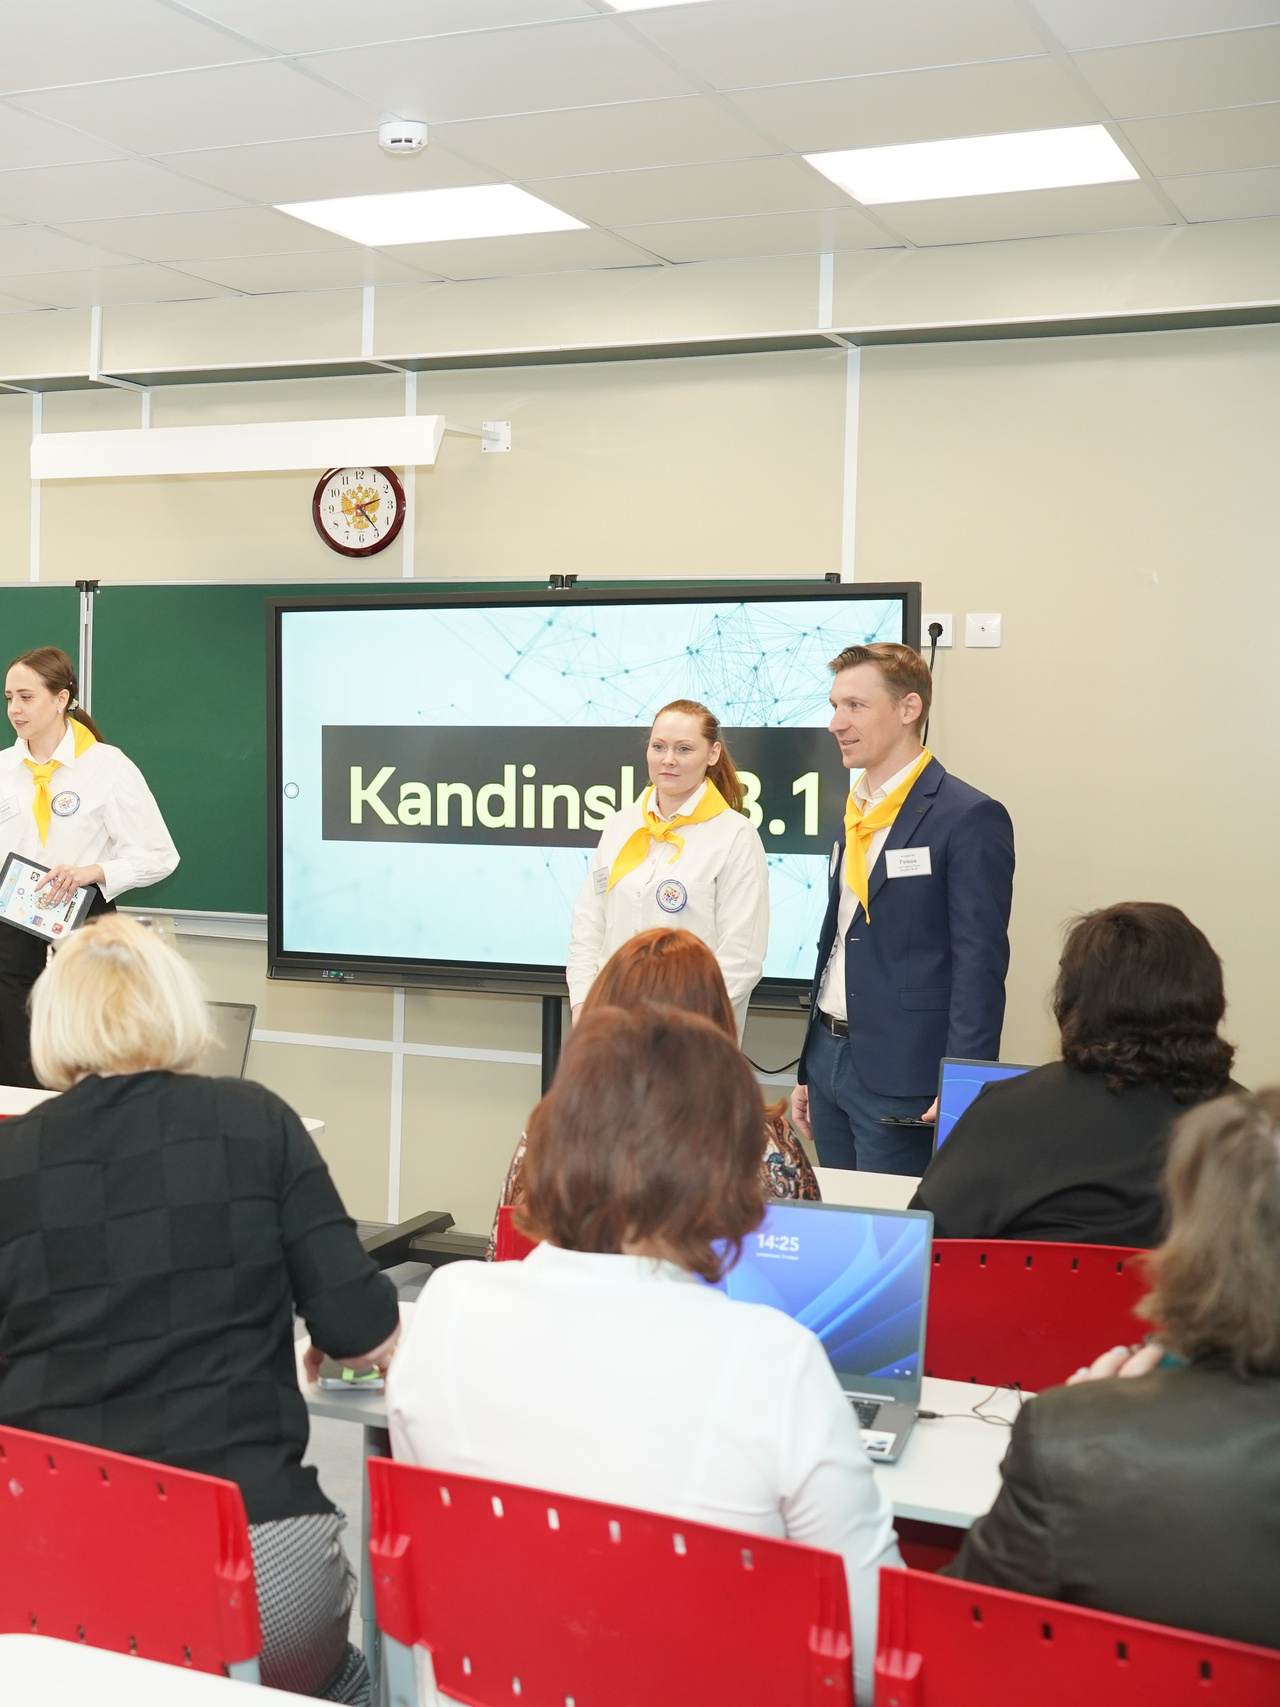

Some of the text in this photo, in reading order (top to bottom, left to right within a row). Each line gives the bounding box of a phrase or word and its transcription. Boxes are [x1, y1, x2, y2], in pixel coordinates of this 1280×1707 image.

[355, 470, 364, 480] 12
[373, 474, 376, 483] 1
[342, 476, 349, 485] 11
[330, 488, 340, 498] 10
[383, 484, 389, 494] 2
[328, 504, 334, 514] 9
[387, 500, 393, 510] 3
[333, 520, 339, 529] 8
[344, 530, 349, 540] 7
[358, 534, 365, 543] 6
[350, 763, 819, 836] Kandinsk 3.1
[757, 1233, 800, 1252] 14:25
